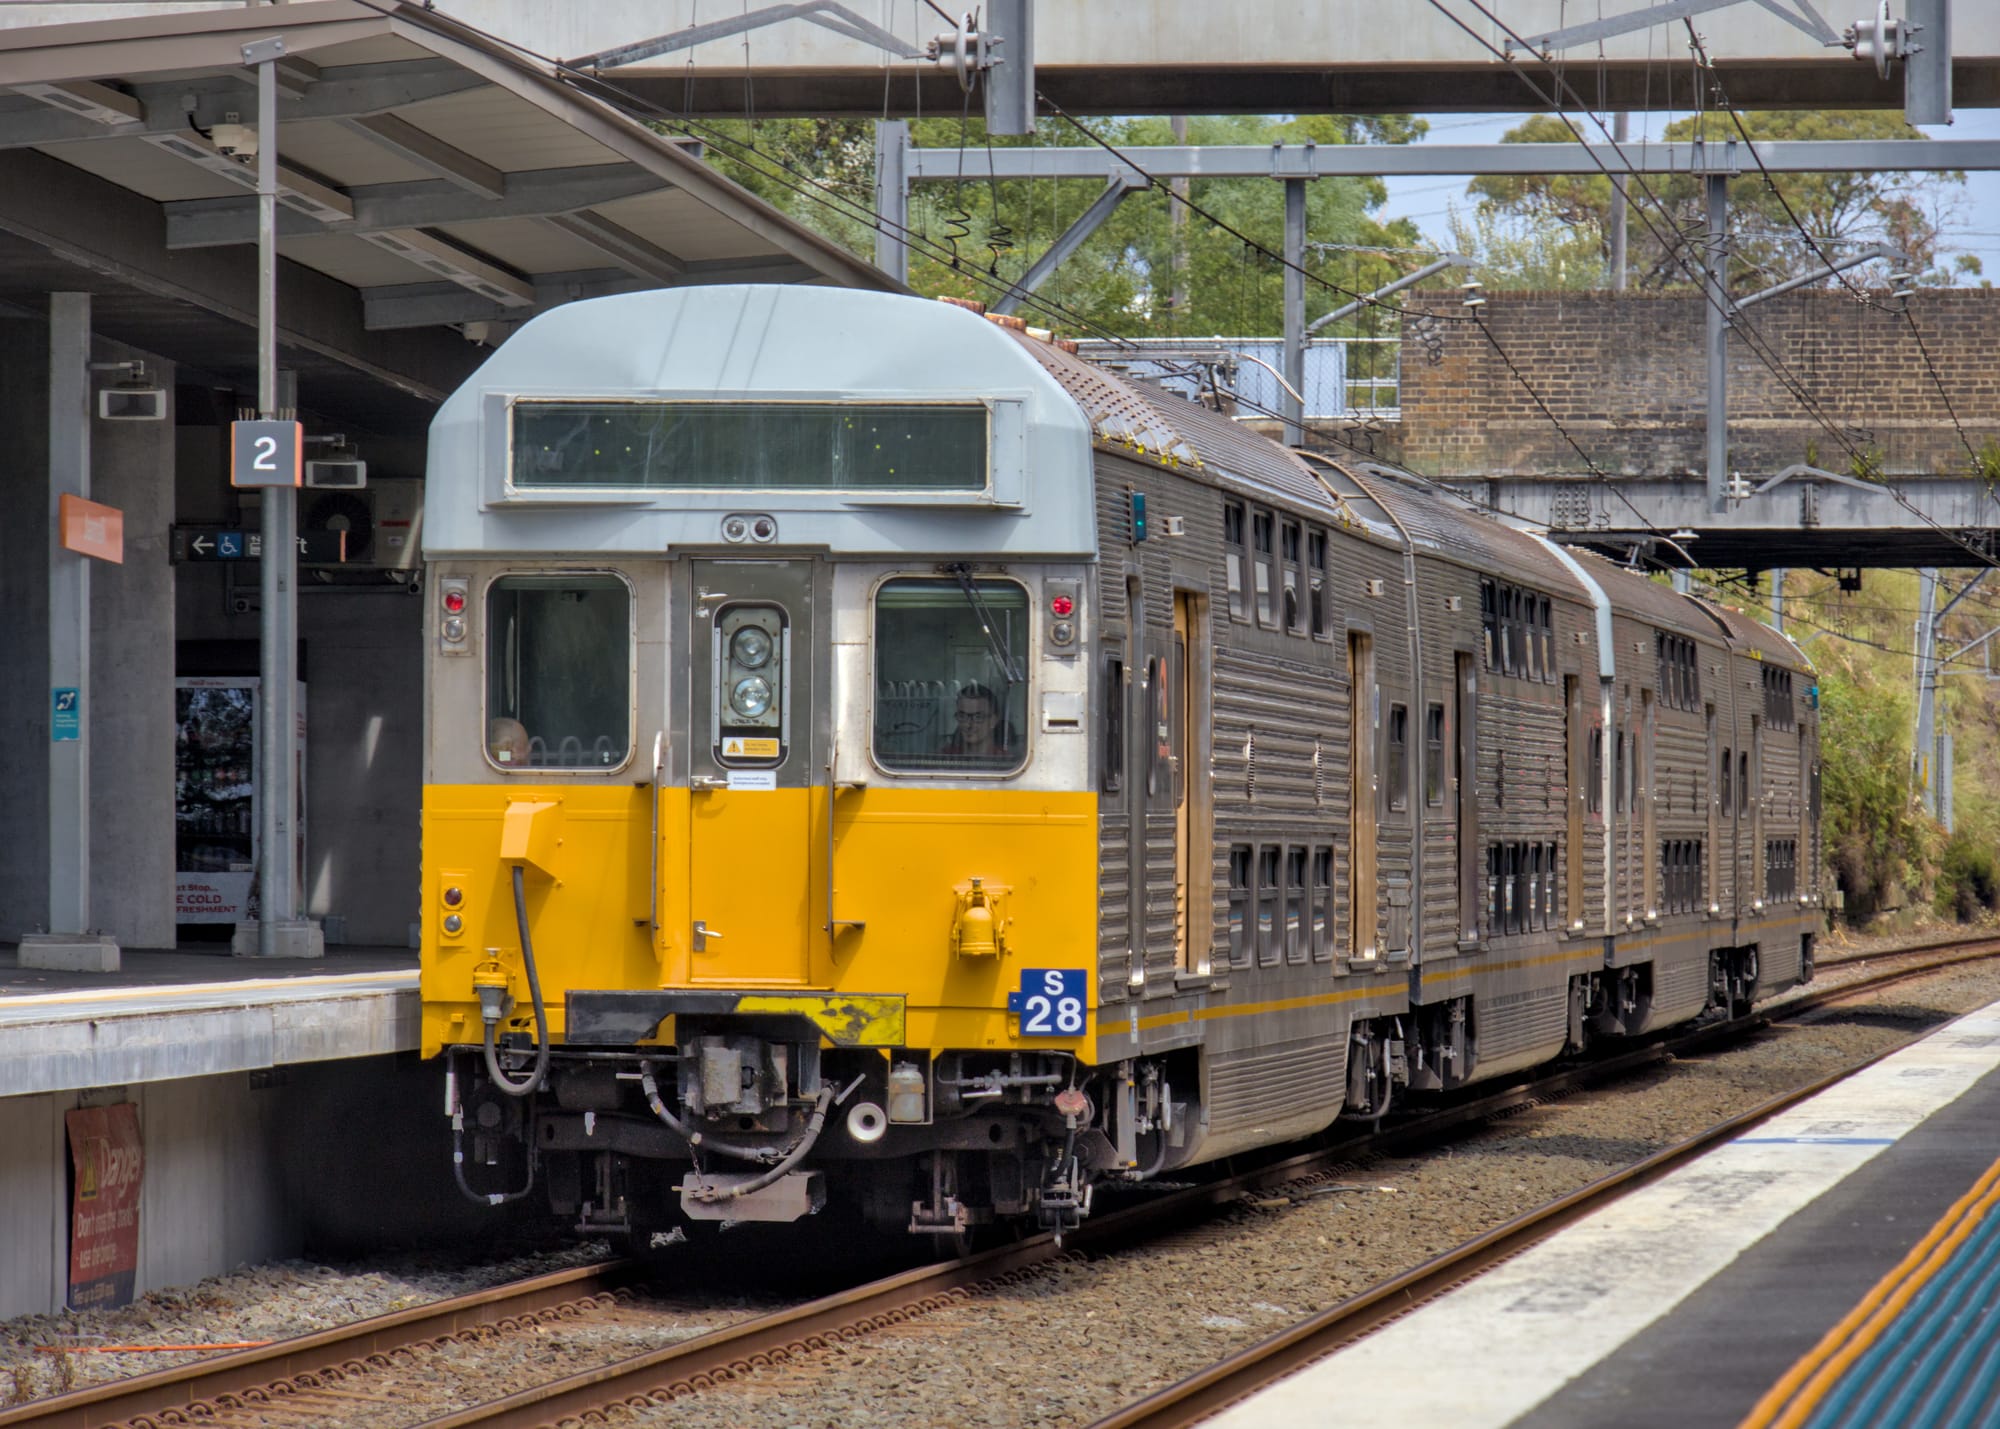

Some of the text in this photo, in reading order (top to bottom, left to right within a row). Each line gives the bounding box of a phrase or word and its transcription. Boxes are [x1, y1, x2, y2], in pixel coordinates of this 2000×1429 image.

[253, 436, 276, 470] 2
[187, 895, 222, 904] COLD
[1044, 970, 1065, 995] S
[1025, 996, 1082, 1032] 28
[100, 1138, 141, 1198] Danger
